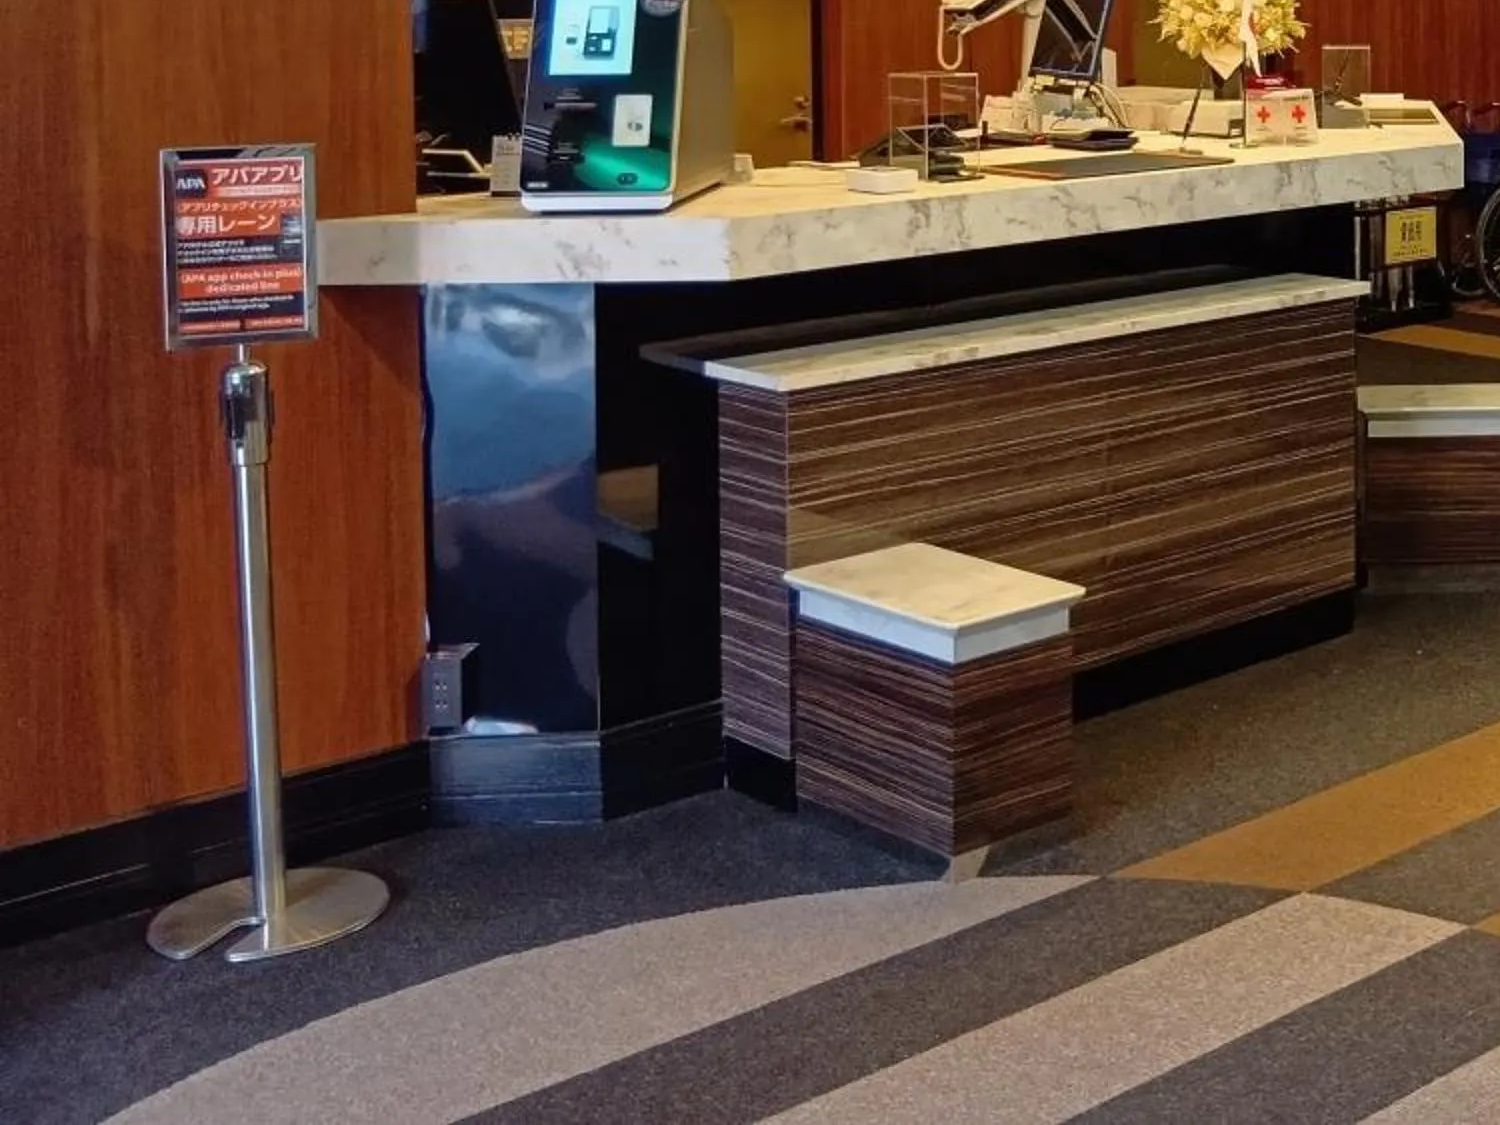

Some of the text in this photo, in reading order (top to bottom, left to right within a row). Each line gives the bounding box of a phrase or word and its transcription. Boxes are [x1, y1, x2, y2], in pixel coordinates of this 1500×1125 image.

[176, 176, 206, 190] APA
[177, 214, 276, 235] 専用レーン
